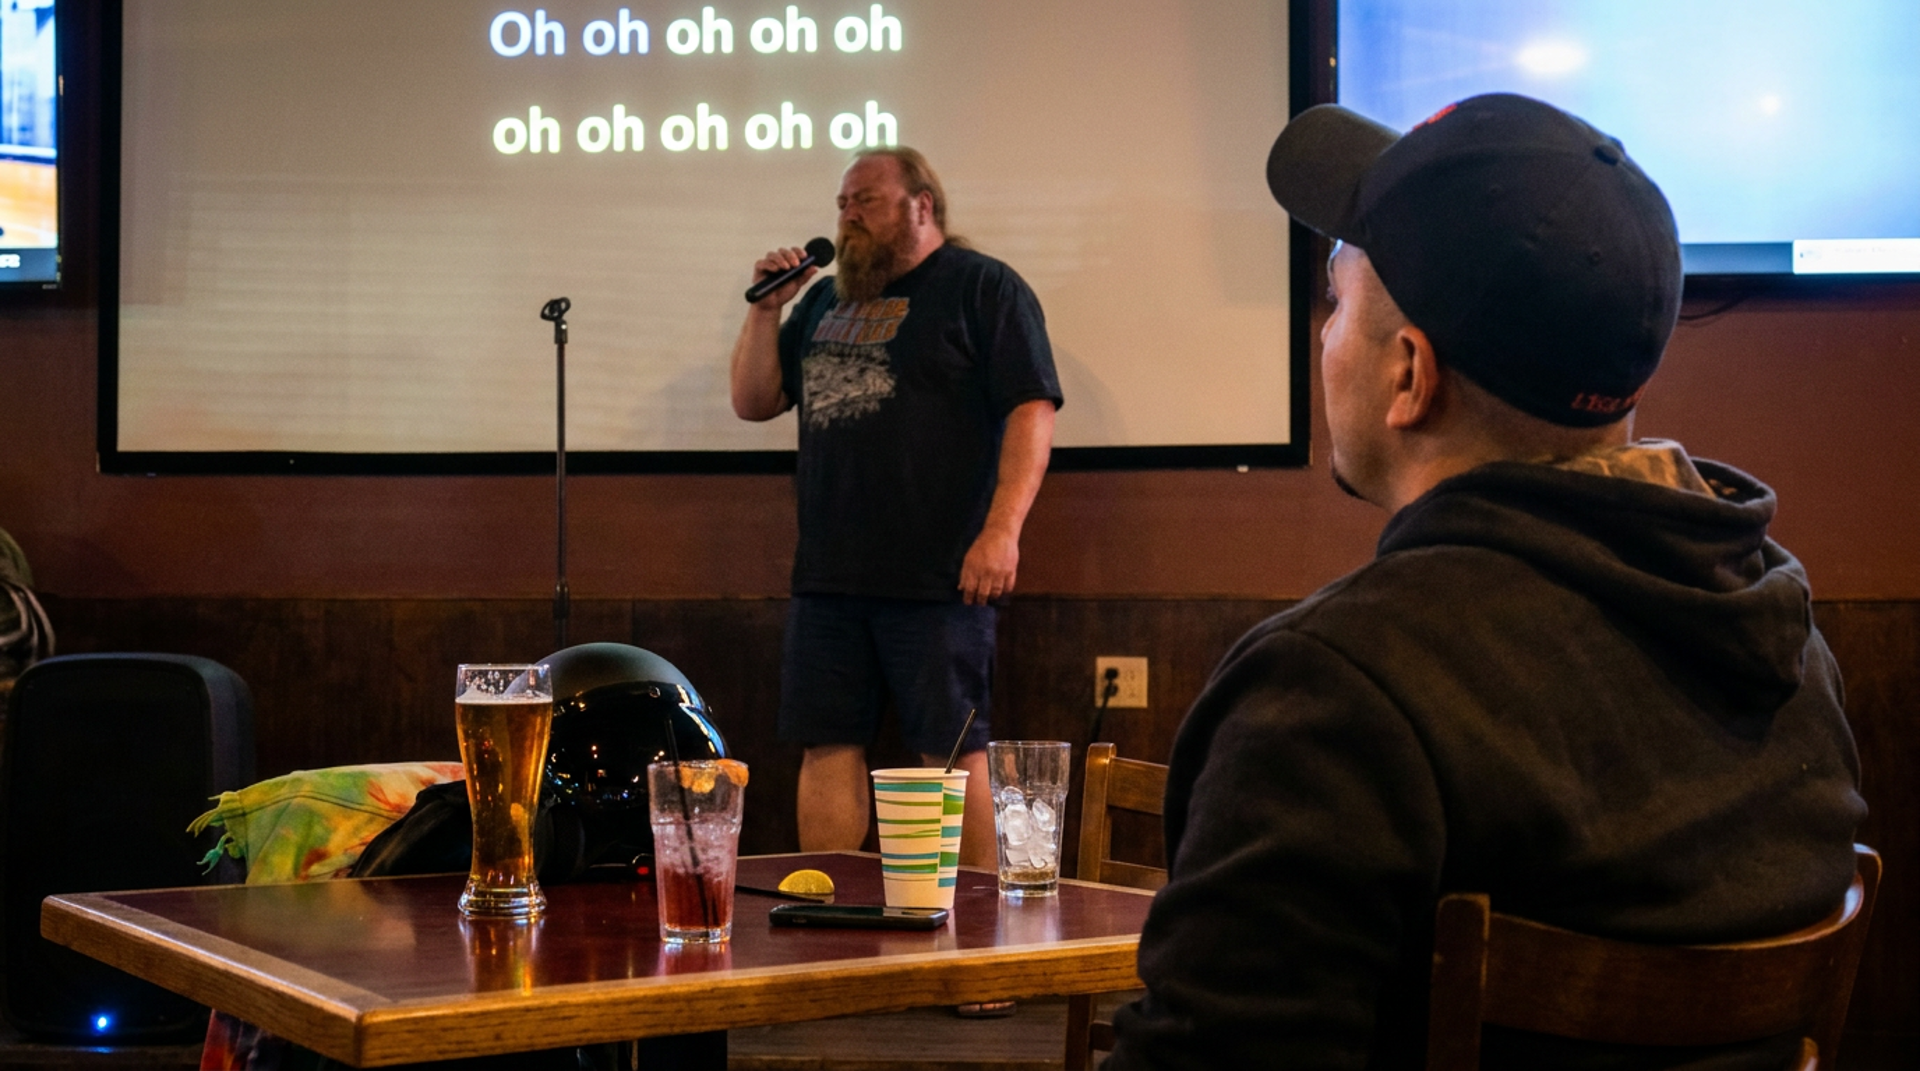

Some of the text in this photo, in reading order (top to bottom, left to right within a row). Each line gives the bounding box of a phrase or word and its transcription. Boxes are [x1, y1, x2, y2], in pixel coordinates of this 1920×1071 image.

[490, 4, 902, 56] Oh oh oh oh oh
[493, 100, 898, 154] oh oh oh oh oh
